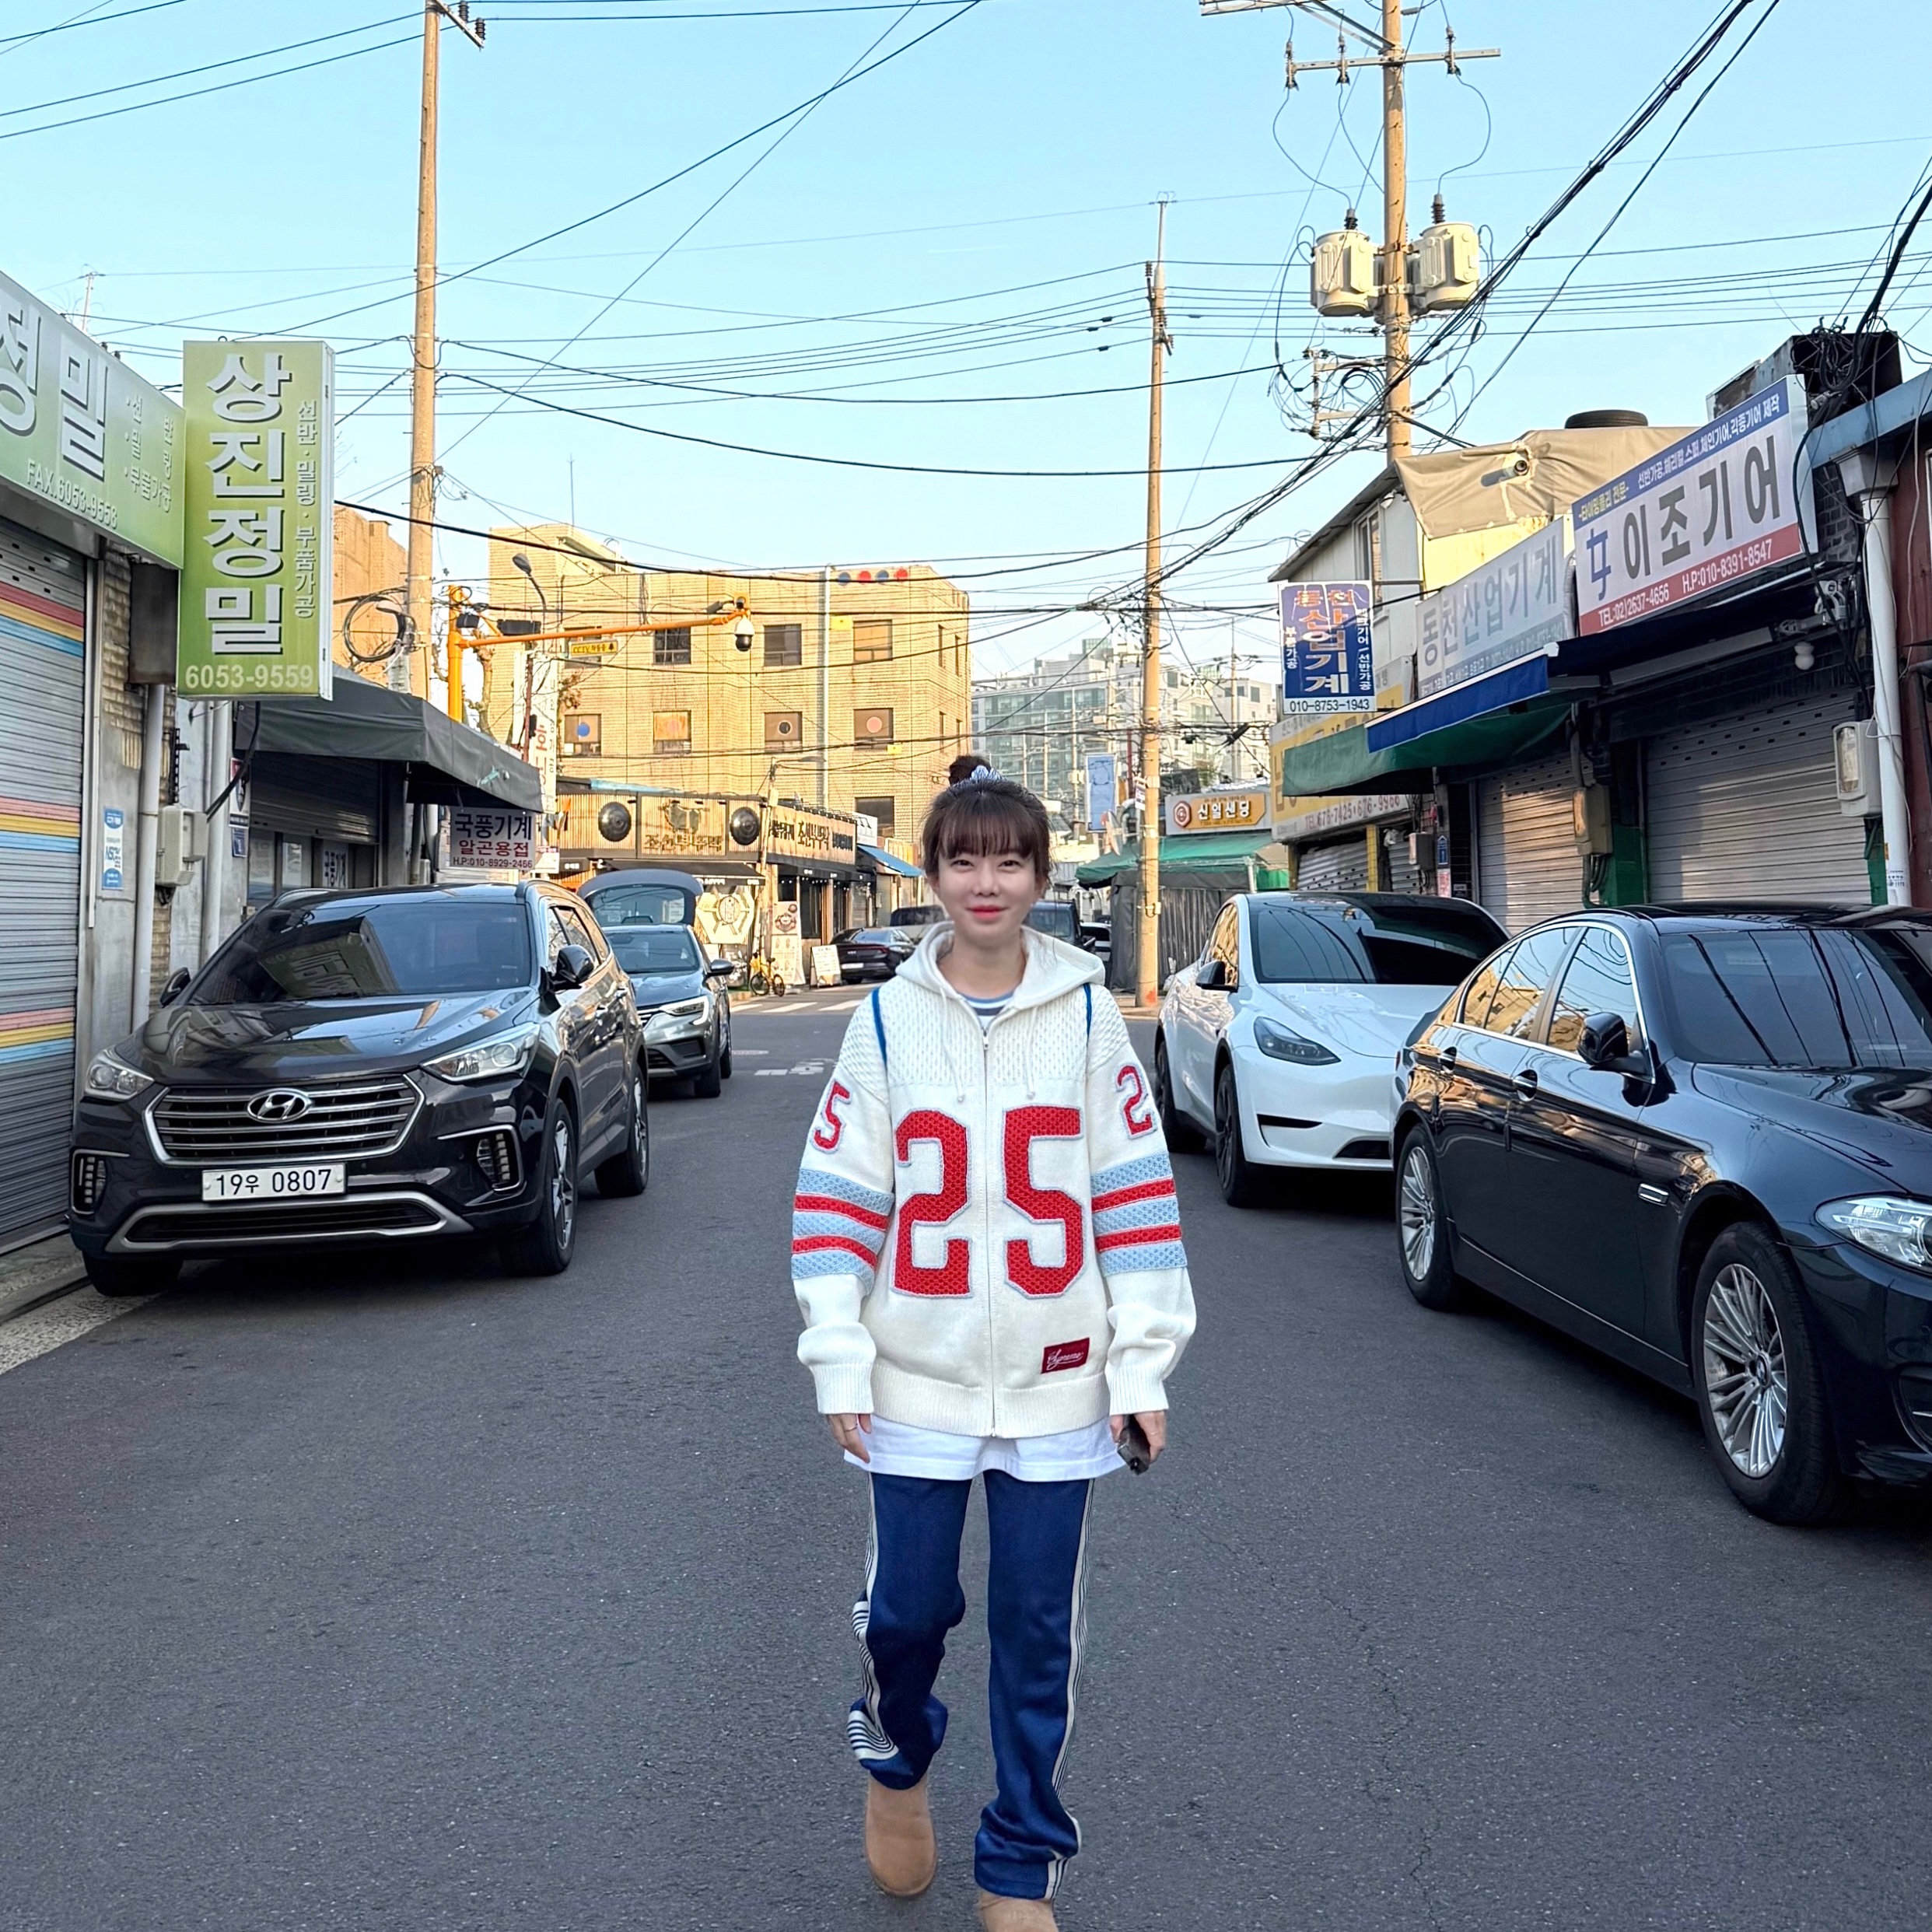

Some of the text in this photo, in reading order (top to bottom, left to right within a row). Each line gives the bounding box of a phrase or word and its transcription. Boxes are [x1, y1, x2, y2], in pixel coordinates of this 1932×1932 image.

[203, 353, 292, 655] 상진정밀
[1623, 435, 1781, 580] 이조기어
[184, 663, 314, 689] 6053-9559
[1290, 699, 1370, 712] 010-8753-1943
[454, 813, 532, 841] 국풍기계
[459, 840, 529, 857] 알곤용접
[810, 1080, 852, 1153] 5
[1115, 1065, 1157, 1139] 2
[215, 1168, 333, 1197] 19우 0807
